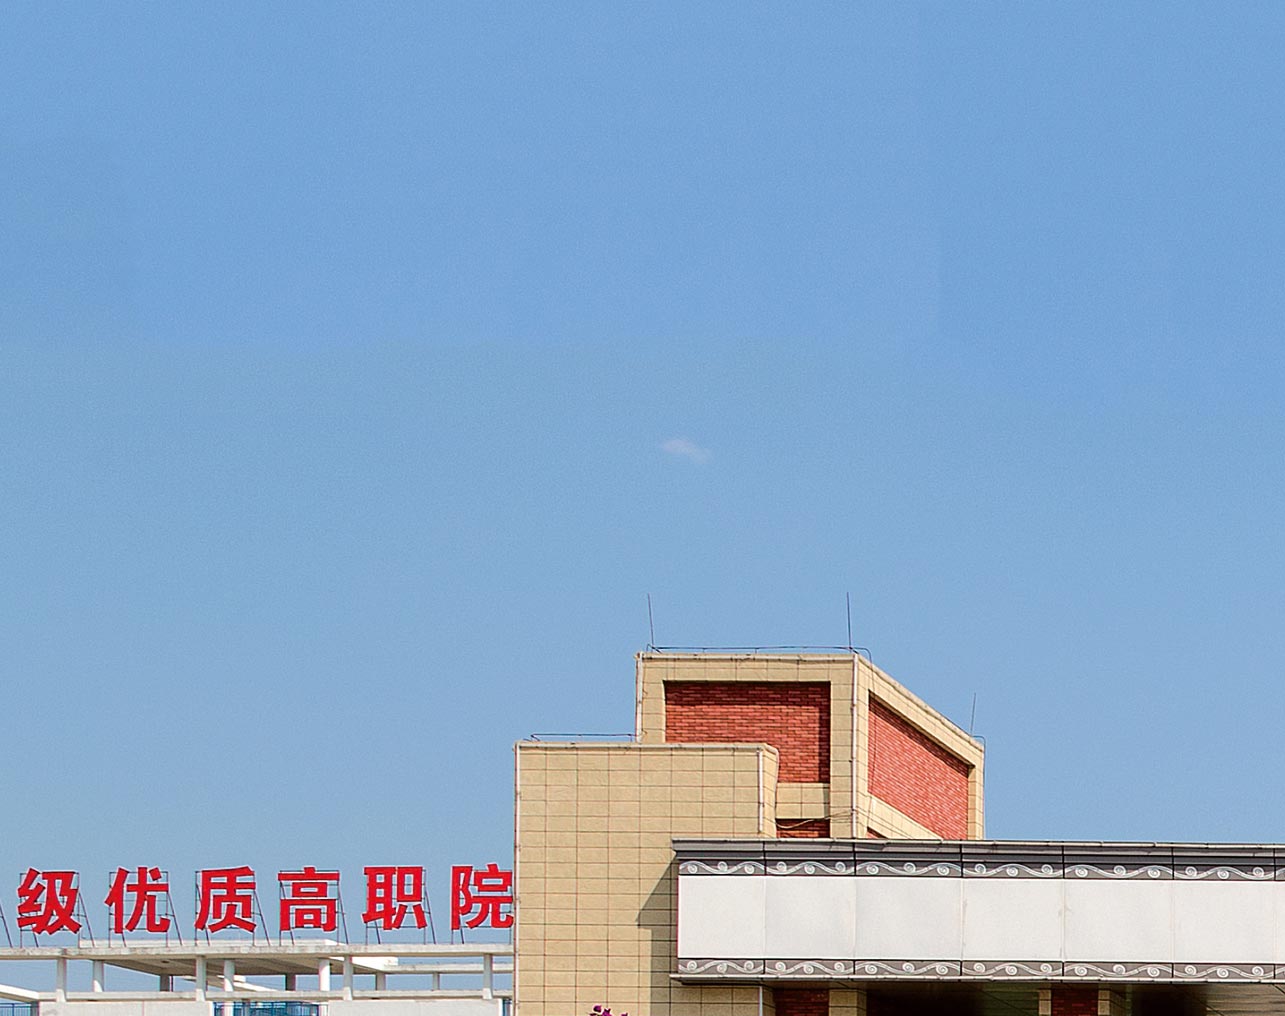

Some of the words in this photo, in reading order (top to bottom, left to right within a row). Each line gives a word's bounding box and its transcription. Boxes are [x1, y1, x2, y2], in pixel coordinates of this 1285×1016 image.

[17, 863, 514, 934] 级优质高职院
